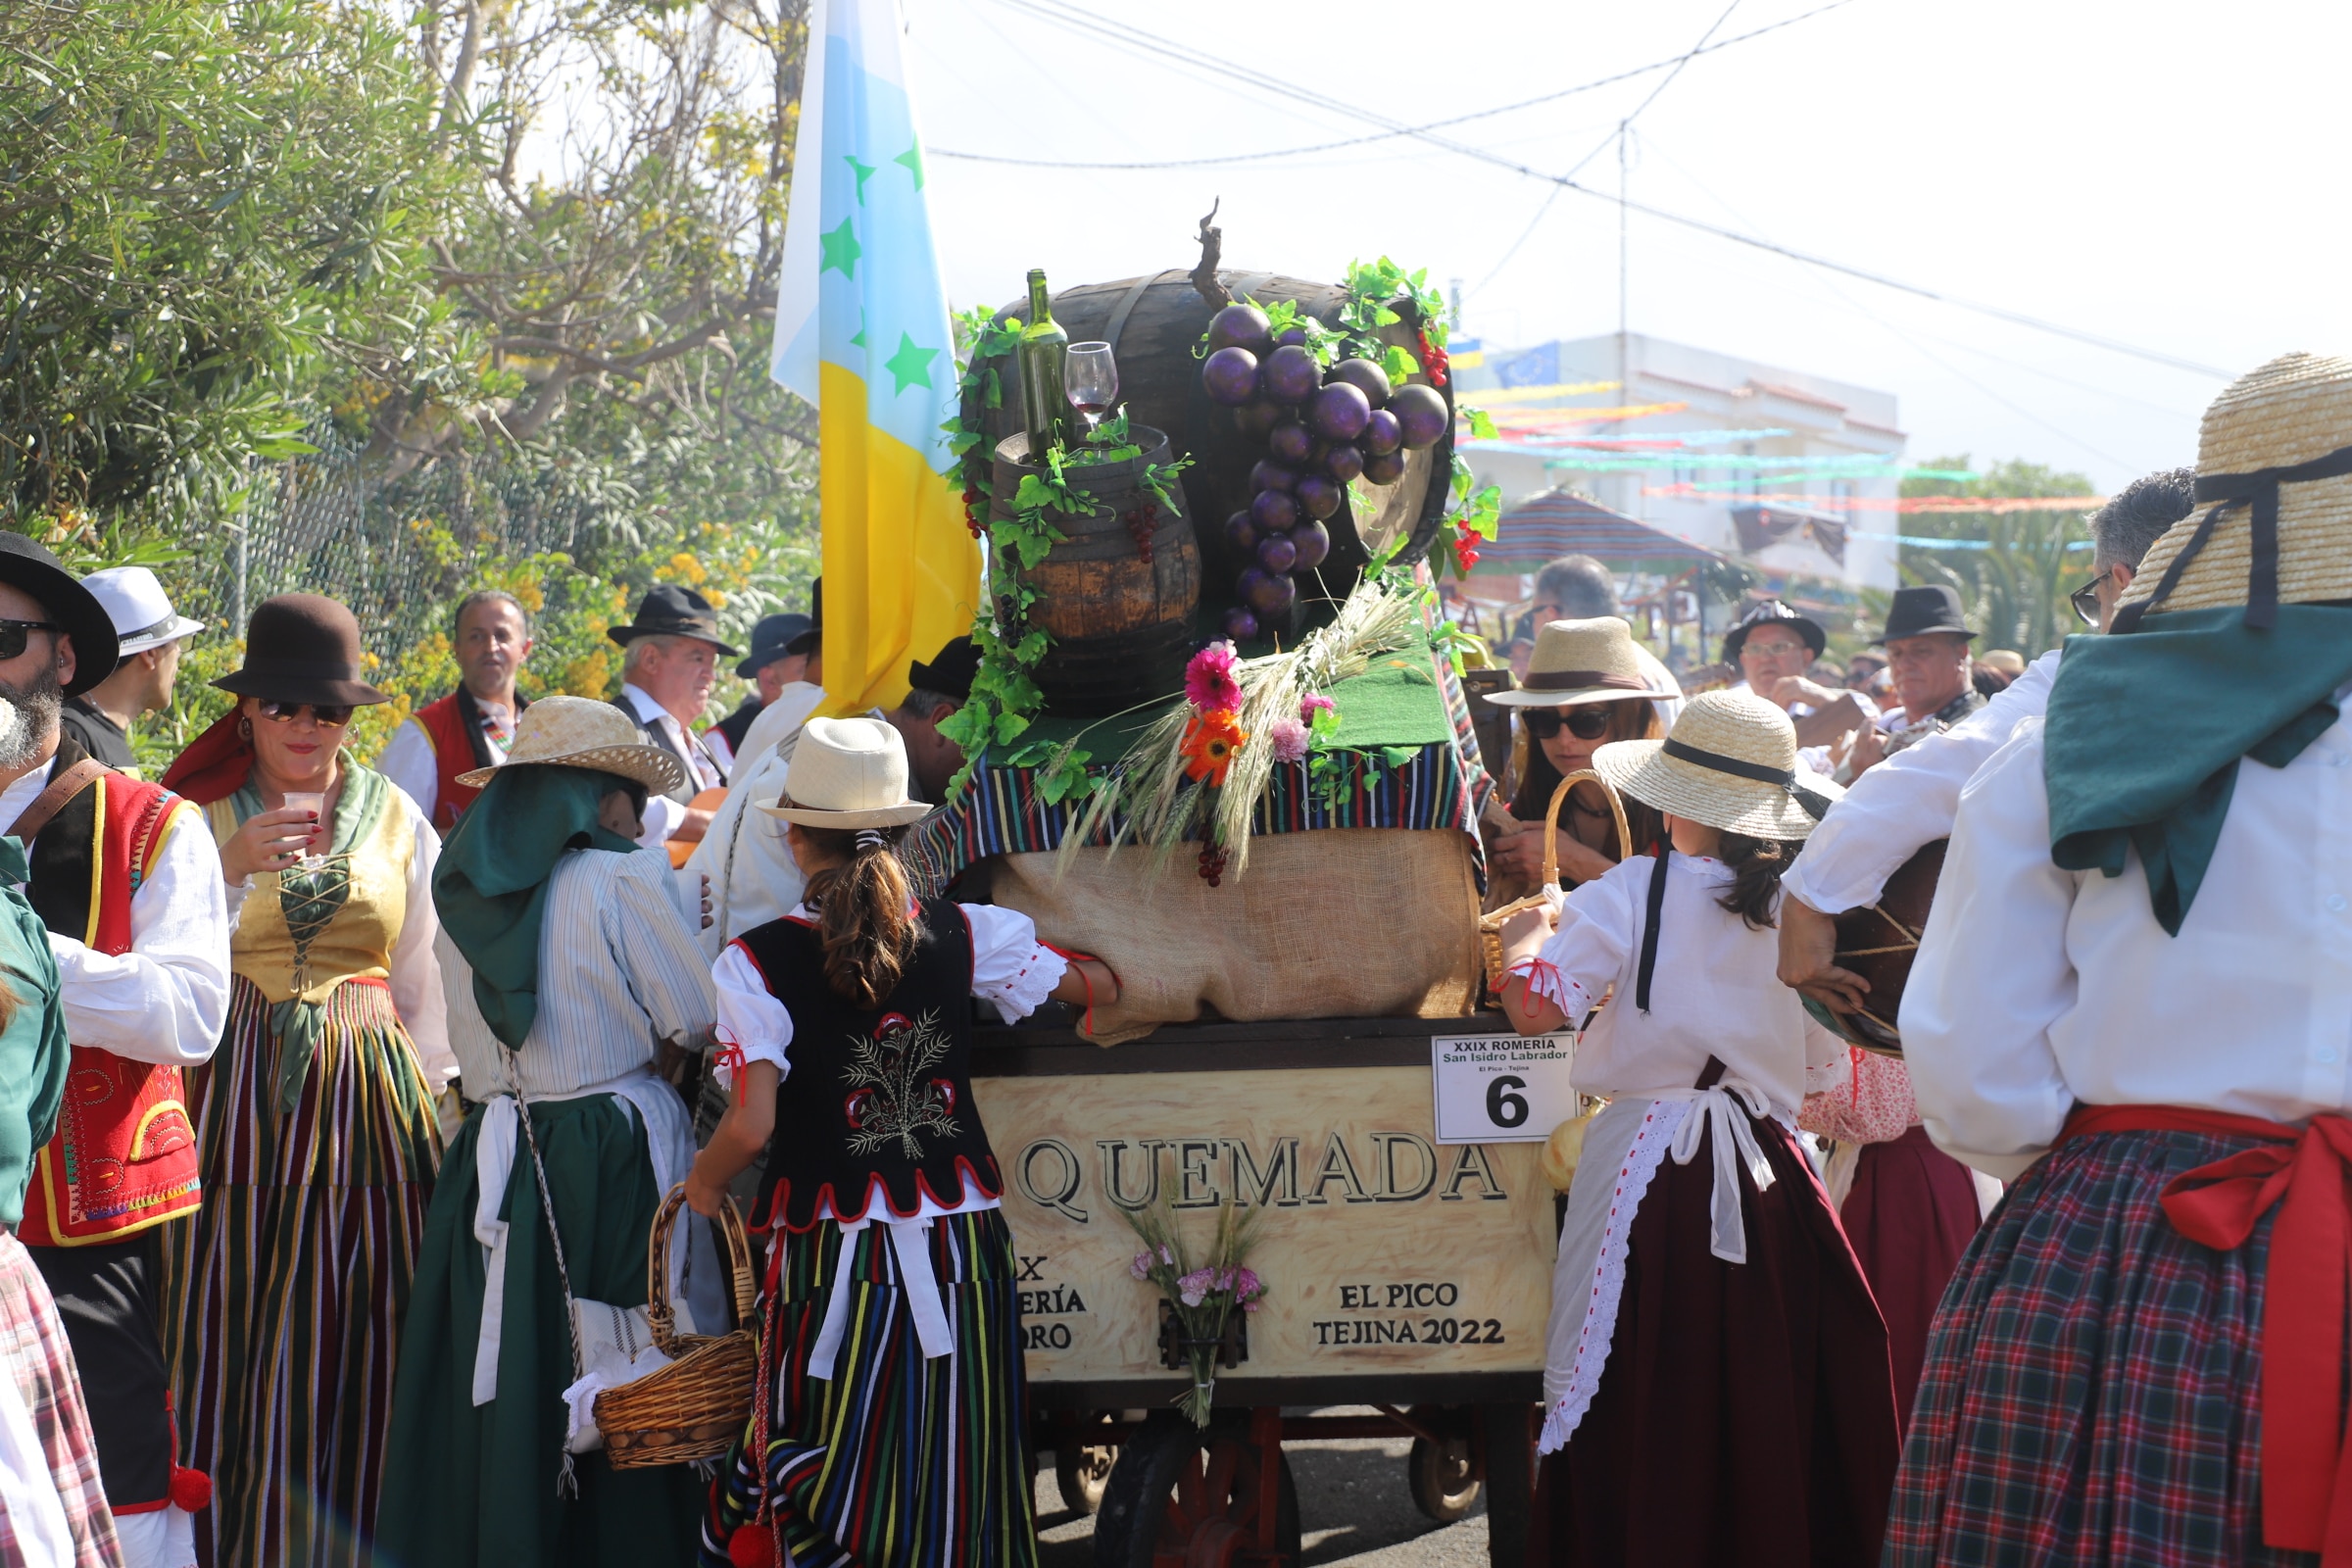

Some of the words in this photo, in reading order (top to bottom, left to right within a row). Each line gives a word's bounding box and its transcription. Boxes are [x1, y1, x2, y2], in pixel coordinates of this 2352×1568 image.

[1443, 1053, 1467, 1063] San
[1471, 1052, 1507, 1062] Isidro
[1510, 1051, 1569, 1061] Labrador
[1453, 1041, 1488, 1053] XXIX
[1492, 1037, 1556, 1052] ROMERÍA
[1486, 1075, 1530, 1129] 6
[1015, 1132, 1508, 1224] QUEMADA
[1340, 1285, 1379, 1309] EL
[1386, 1283, 1458, 1308] PICO
[1313, 1320, 1418, 1345] TEJINA
[1421, 1318, 1505, 1345] 2022
